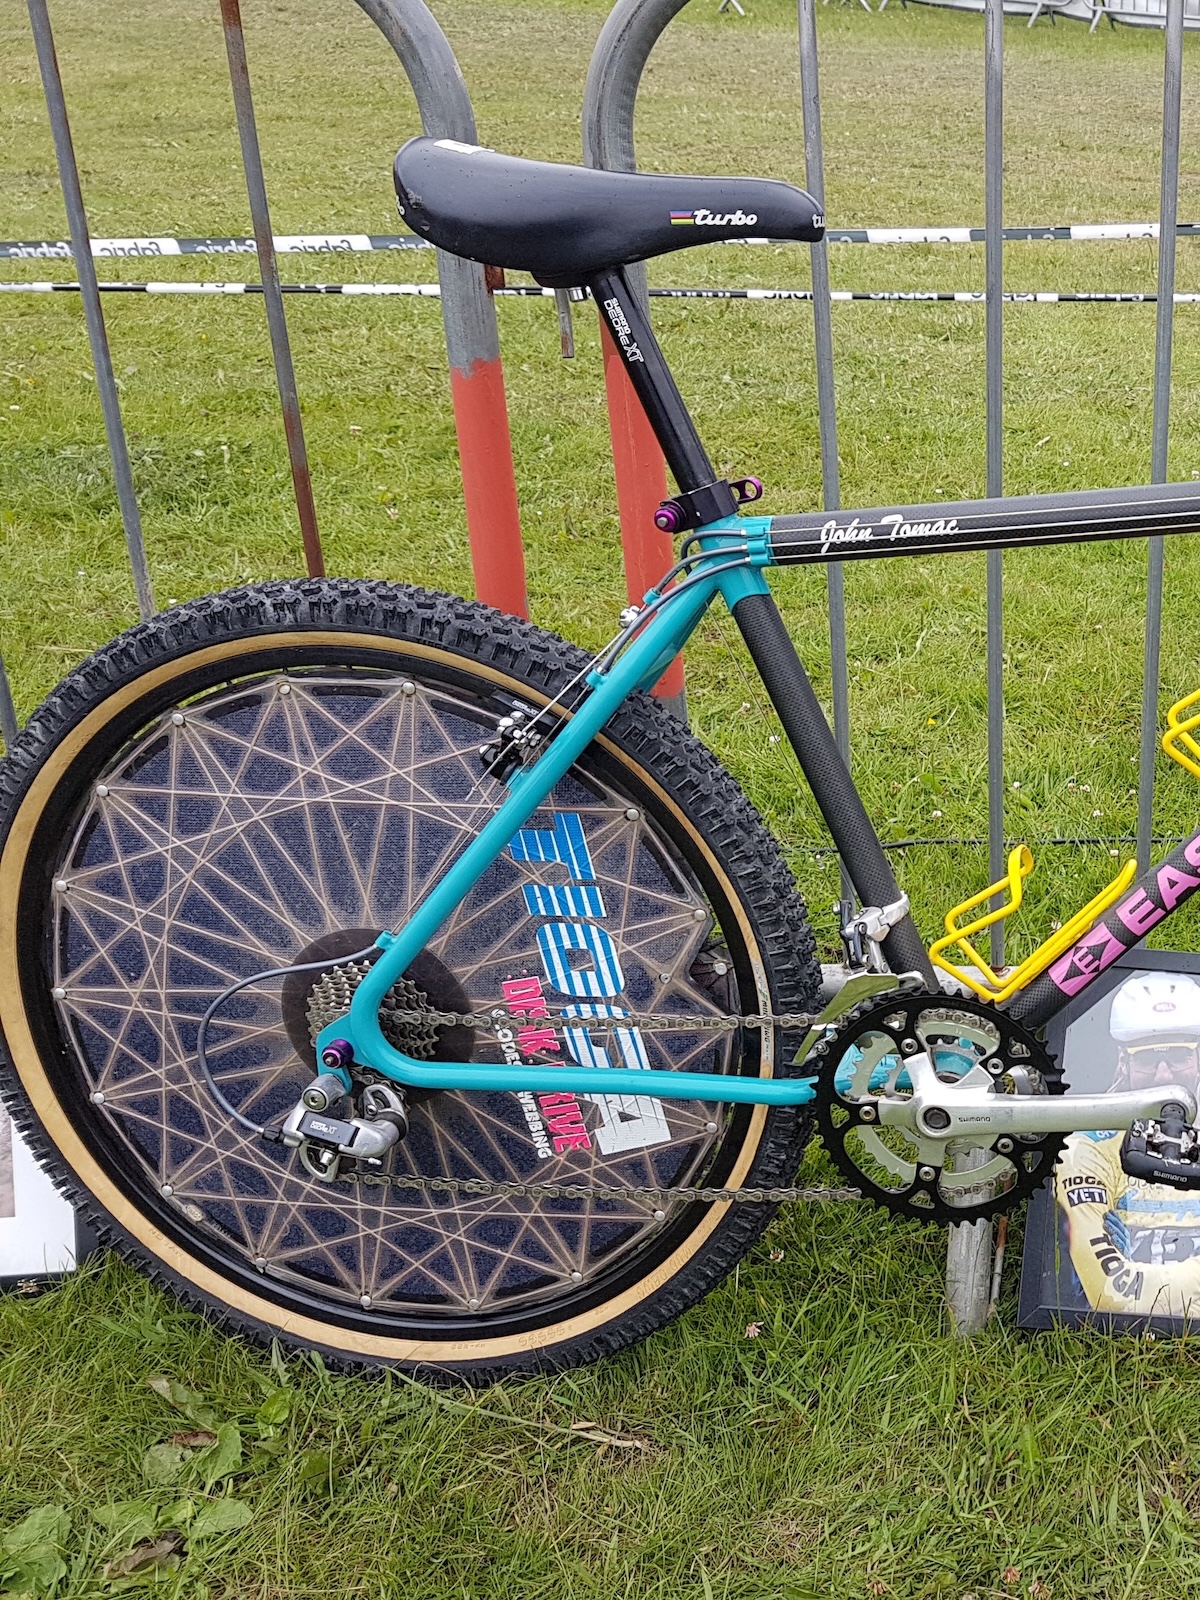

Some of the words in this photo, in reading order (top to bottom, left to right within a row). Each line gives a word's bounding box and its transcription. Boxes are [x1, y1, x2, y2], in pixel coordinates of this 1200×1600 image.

[693, 208, 758, 226] turbo
[604, 299, 630, 346] DEORE
[623, 342, 645, 363] XT
[820, 517, 873, 554] John
[880, 514, 960, 541] Tomac
[517, 1090, 553, 1159] WEBBING
[537, 1062, 592, 1153] RIVE
[1061, 1176, 1107, 1188] TIOGA
[1153, 1170, 1188, 1183] SHIMANO
[1068, 1188, 1107, 1207] YETI
[1089, 1233, 1145, 1301] TIOGA
